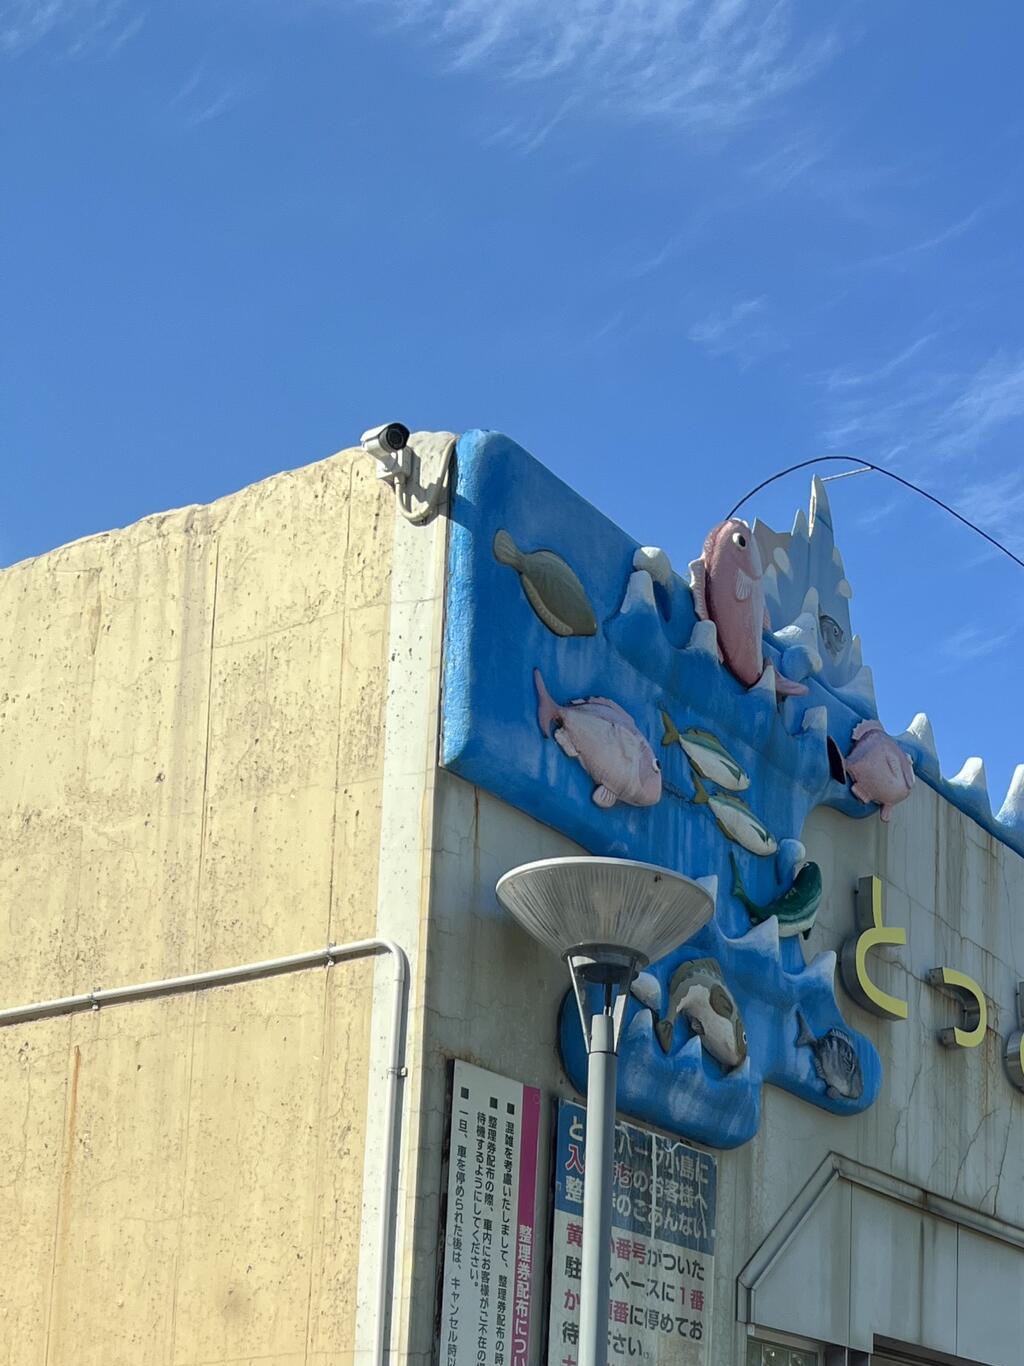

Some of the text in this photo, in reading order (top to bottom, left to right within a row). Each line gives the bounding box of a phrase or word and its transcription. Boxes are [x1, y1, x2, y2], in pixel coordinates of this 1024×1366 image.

[469, 1111, 487, 1288] 待機するようにしてください。
